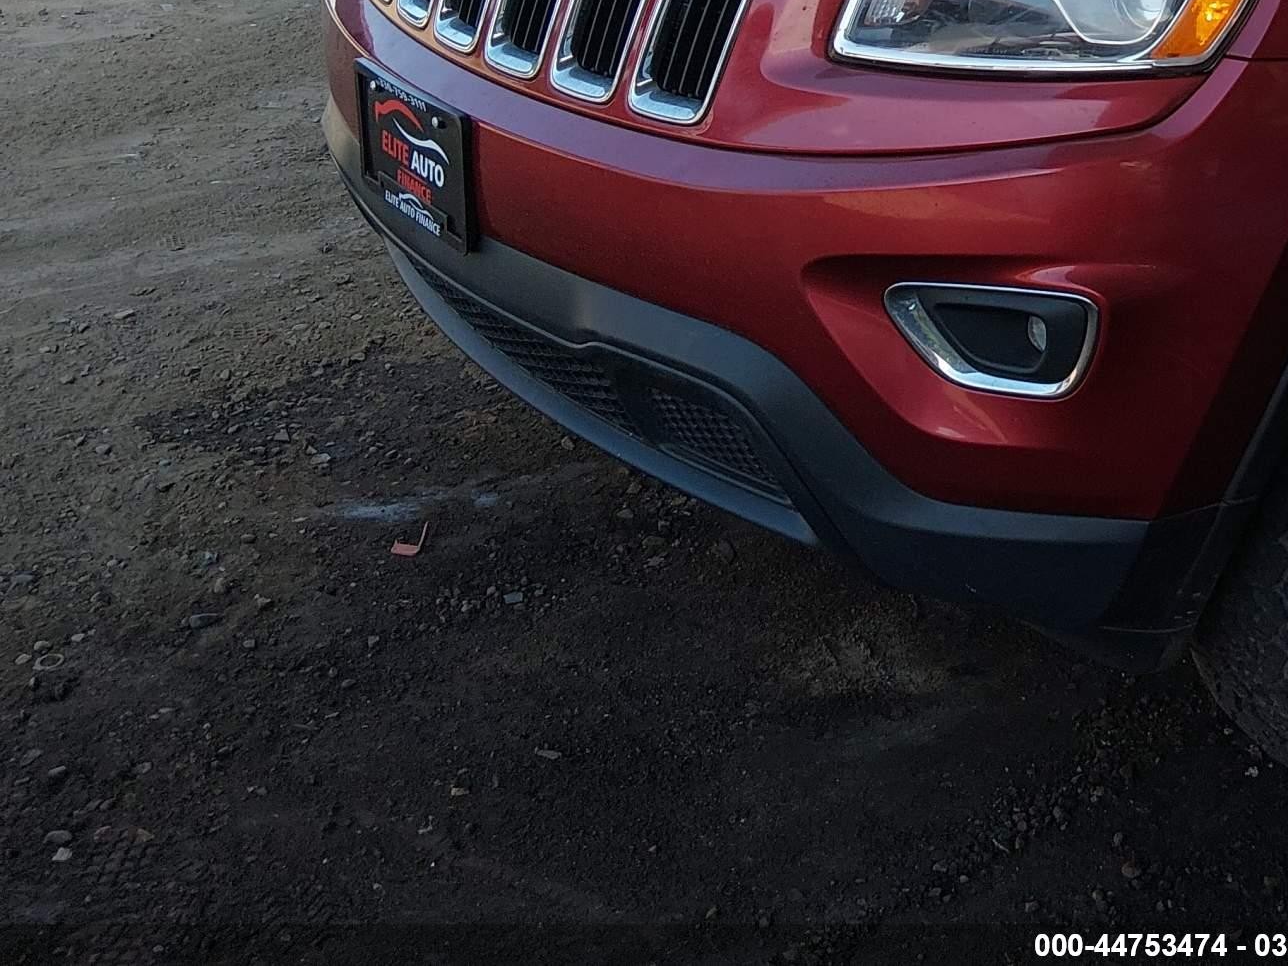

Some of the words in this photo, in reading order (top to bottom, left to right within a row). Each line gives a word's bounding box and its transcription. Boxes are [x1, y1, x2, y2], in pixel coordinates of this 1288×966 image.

[381, 129, 410, 167] ELITE
[411, 151, 445, 188] AUTO
[396, 169, 433, 205] FINANCE
[385, 190, 400, 209] ELITE
[399, 201, 415, 219] AUTO
[415, 212, 441, 237] FINANCE
